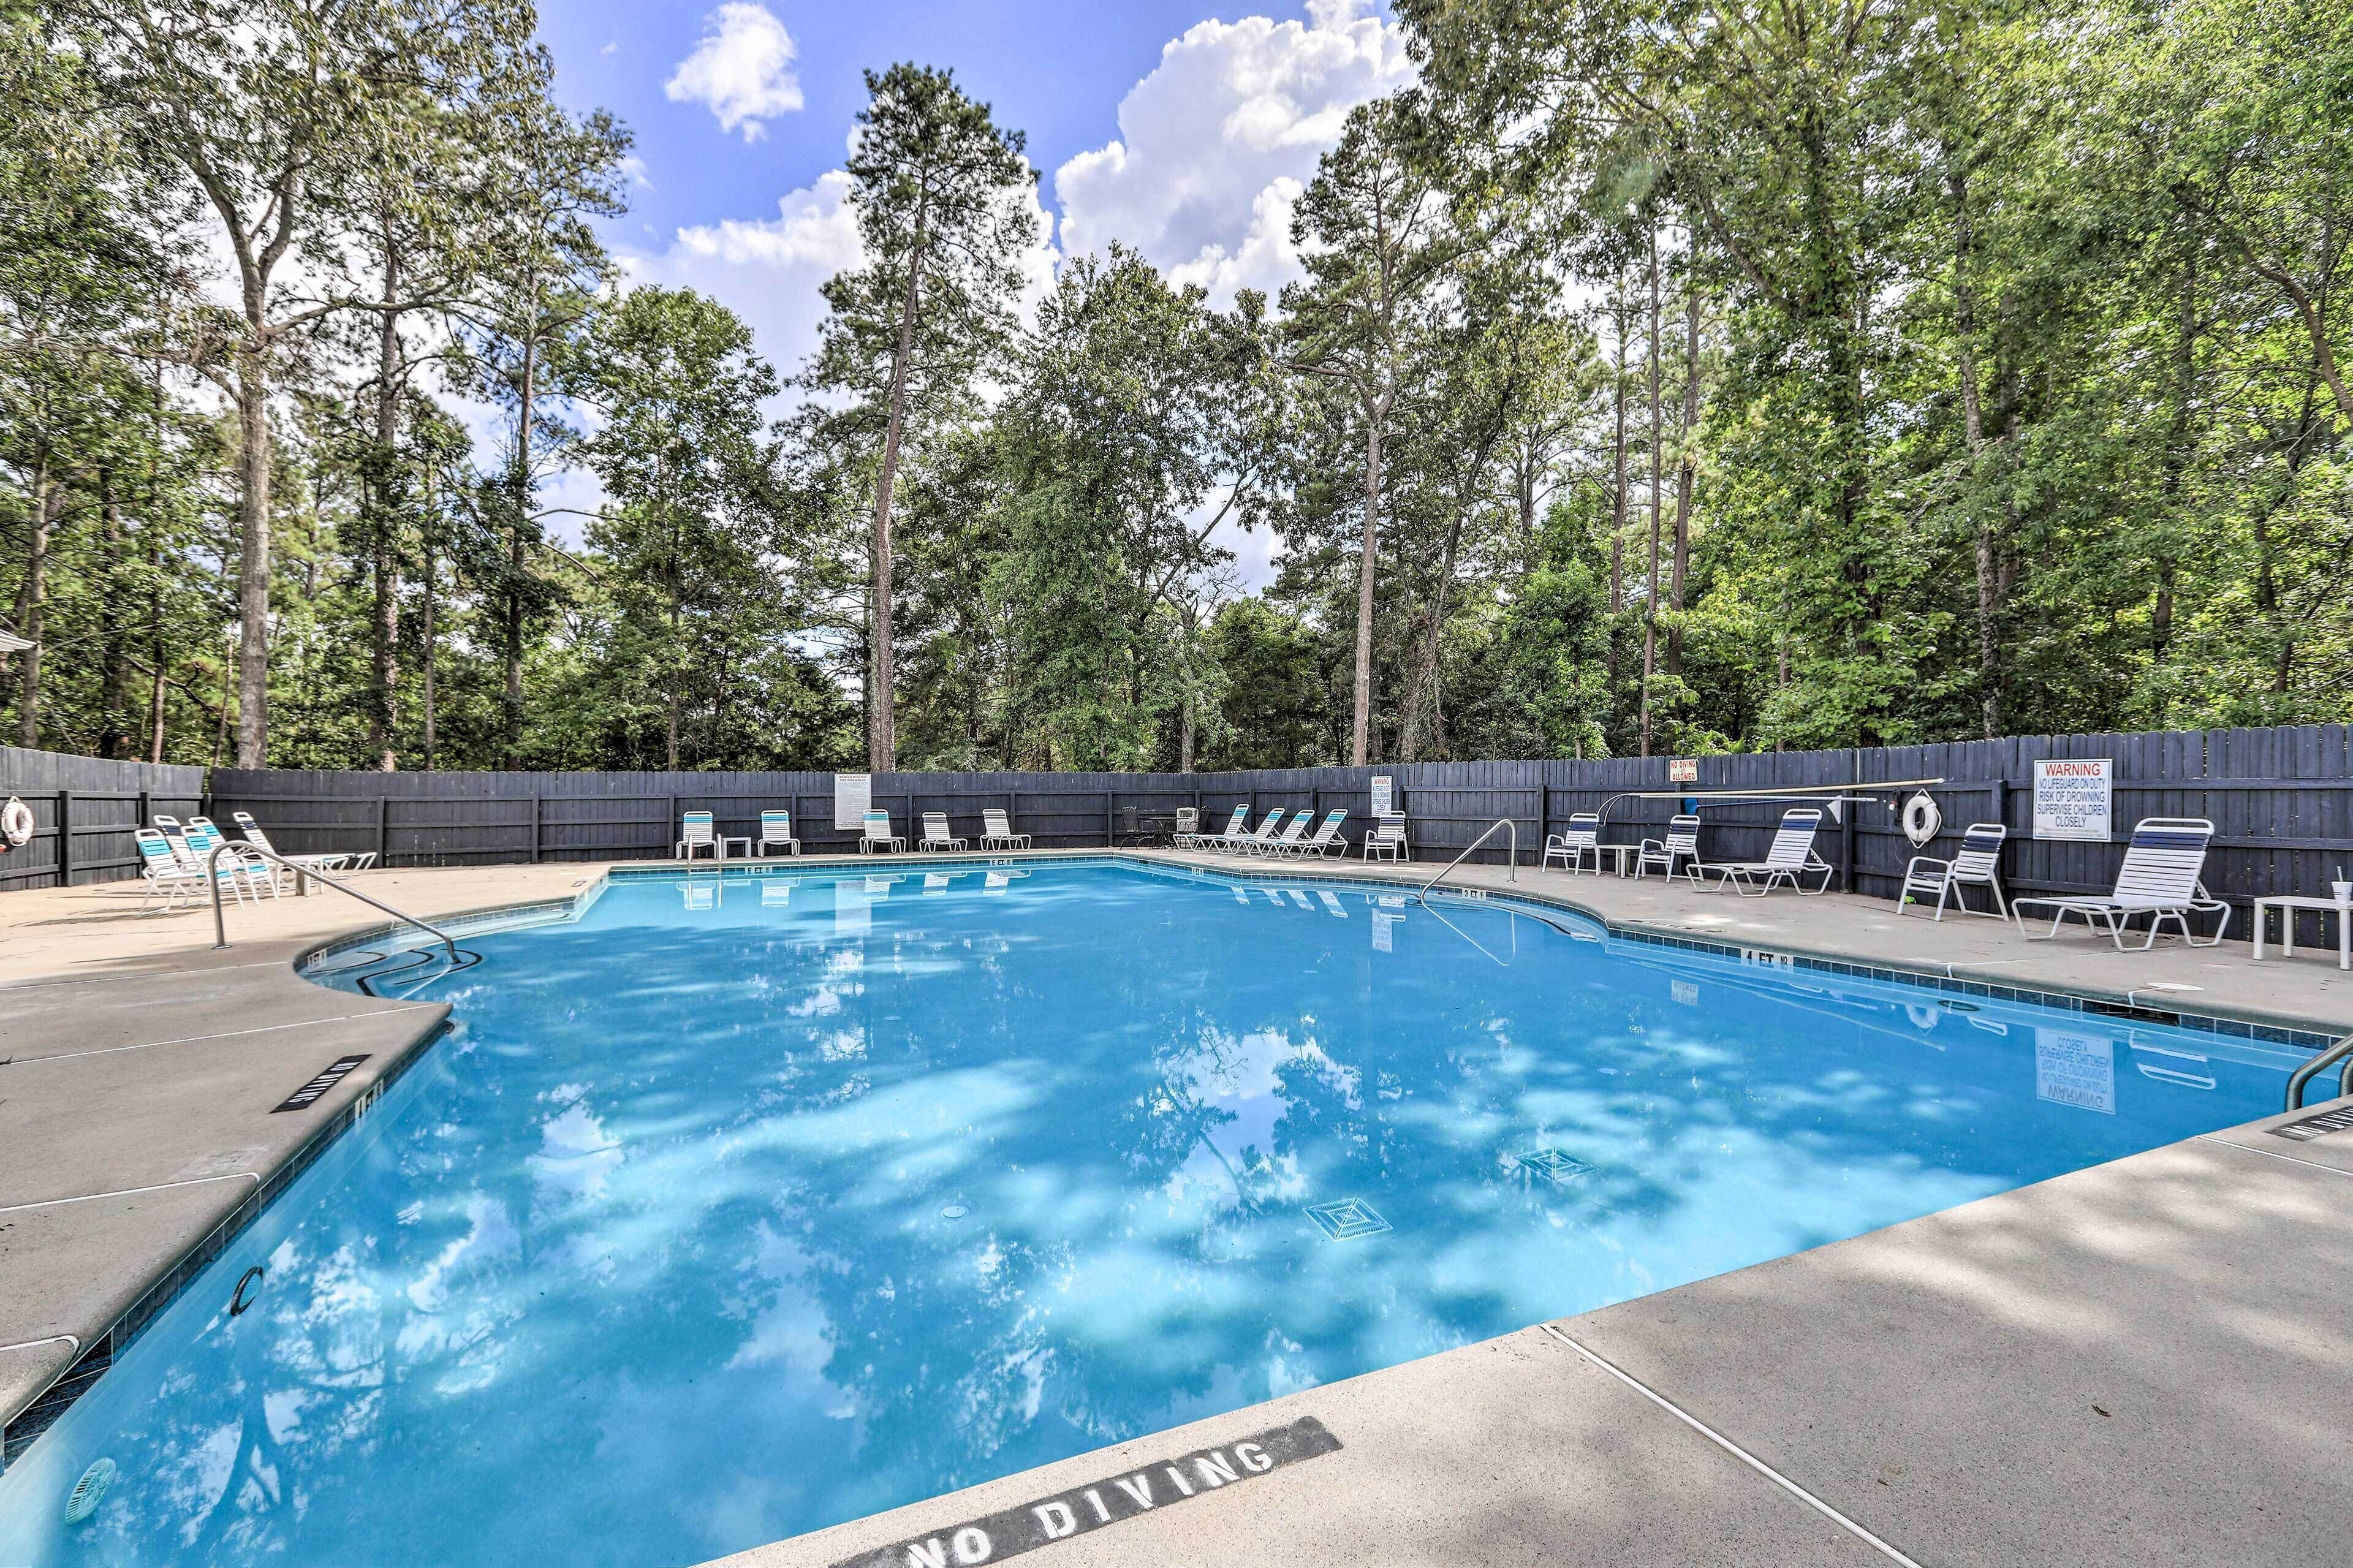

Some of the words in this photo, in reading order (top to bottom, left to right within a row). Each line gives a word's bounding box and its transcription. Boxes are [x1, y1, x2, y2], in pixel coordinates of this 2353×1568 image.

[2045, 763, 2101, 776] WARNING
[2039, 778, 2047, 789] NO
[2048, 778, 2079, 789] LIFEGUARD
[2080, 778, 2088, 789] ON
[2090, 778, 2106, 789] DUTY
[2039, 791, 2054, 801] RISK
[2056, 791, 2065, 801] OF
[2067, 791, 2105, 802] DROWNING
[2037, 804, 2072, 814] SUPERVISE
[2074, 804, 2107, 816] CHILDREN
[2055, 816, 2086, 827] CLOSELY
[1759, 952, 1774, 963] FT
[329, 1061, 360, 1071] NO
[288, 1073, 344, 1103] DIVING
[2281, 1125, 2327, 1137] NO
[2309, 1108, 2353, 1129] DIV
[907, 1527, 992, 1568] NO
[1032, 1441, 1274, 1539] DIVING
